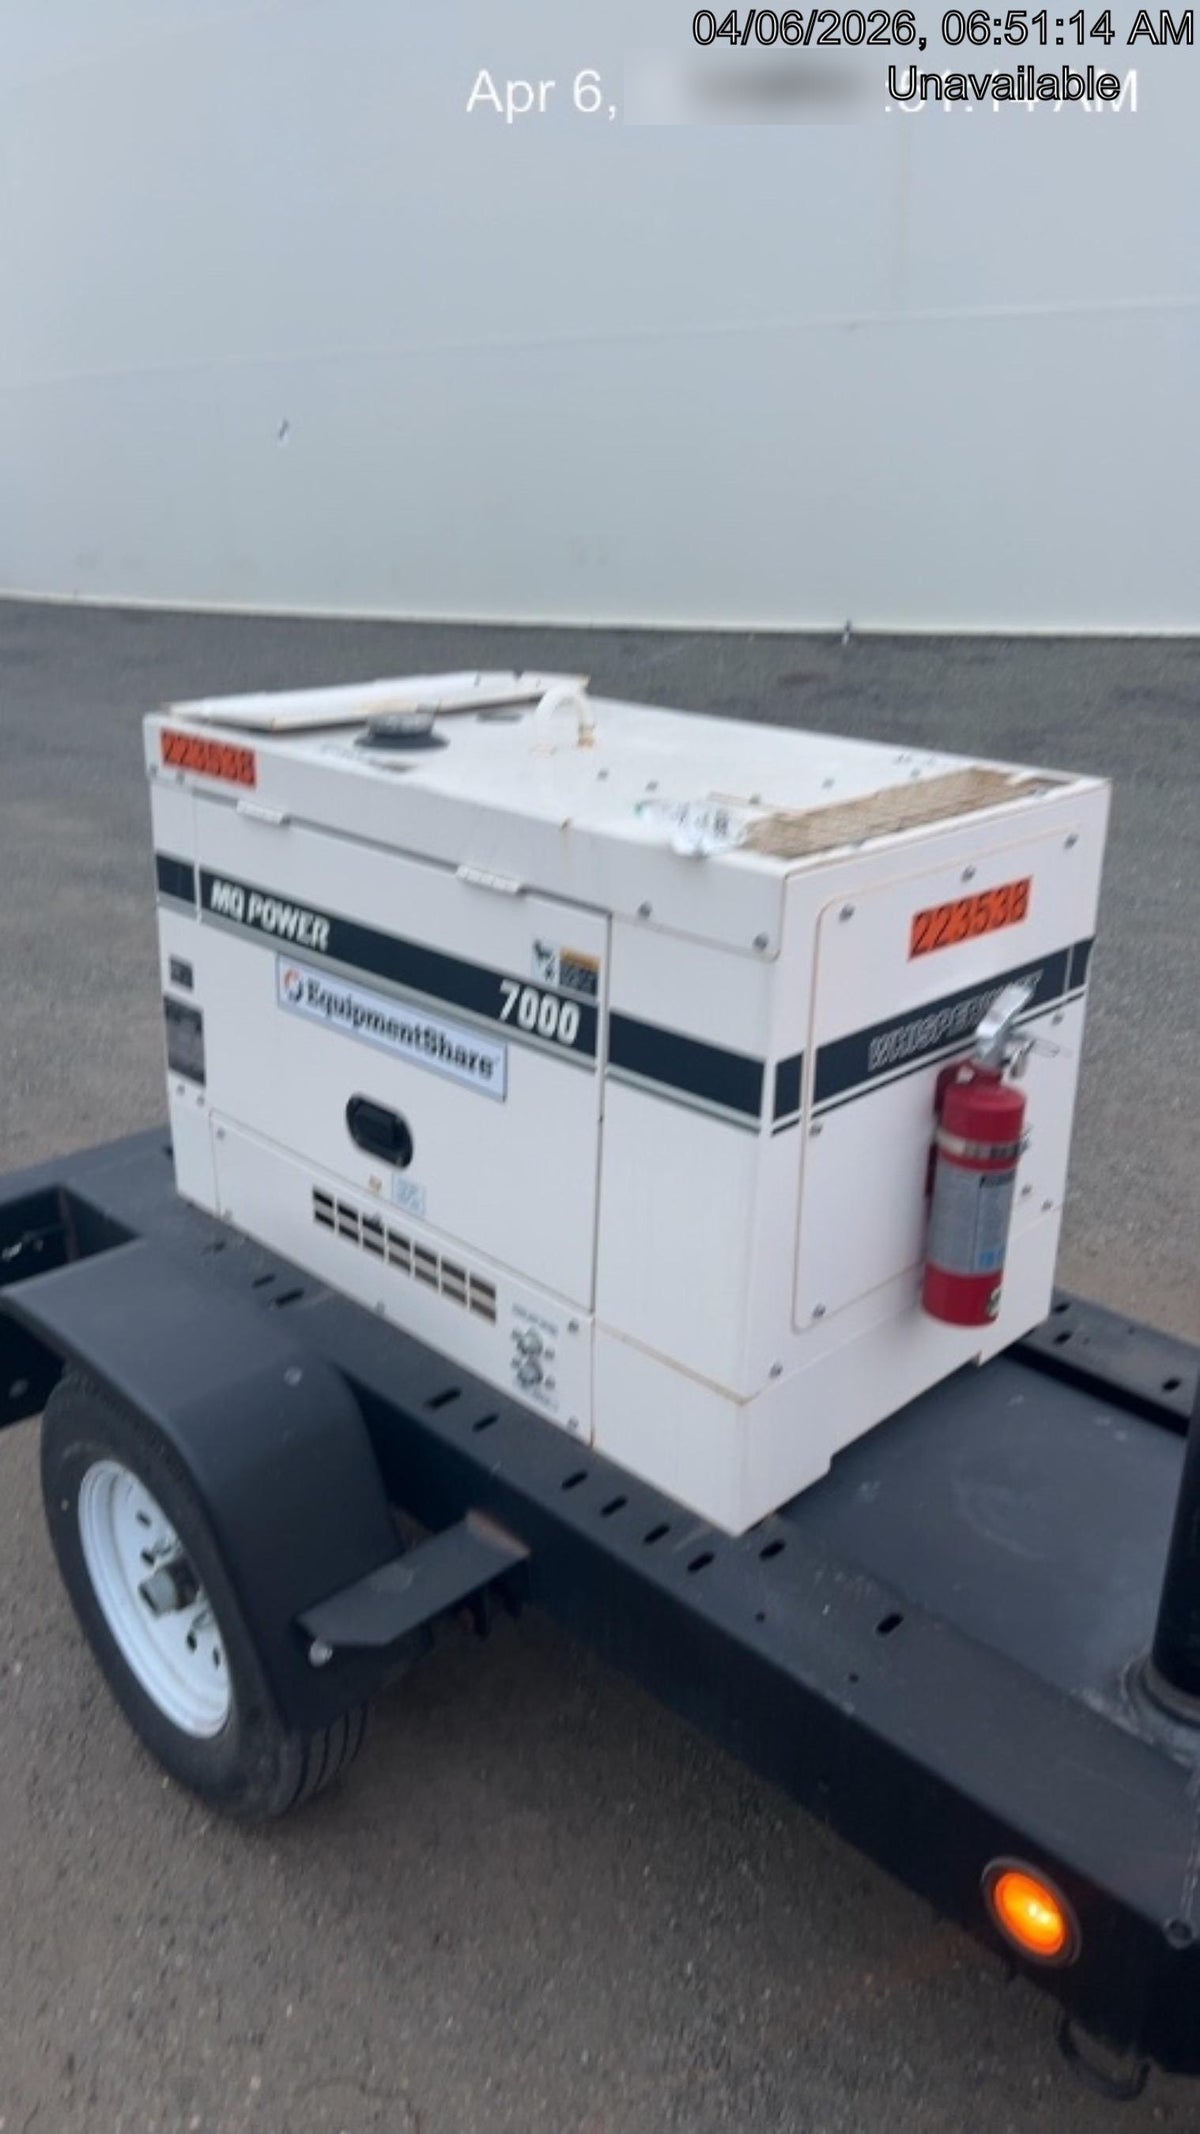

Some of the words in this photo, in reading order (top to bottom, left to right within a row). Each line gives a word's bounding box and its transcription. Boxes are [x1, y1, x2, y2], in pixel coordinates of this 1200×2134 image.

[210, 879, 245, 920] MQ
[246, 890, 330, 951] POWER
[909, 878, 1030, 959] 223538
[304, 974, 494, 1082] EquipmentShare
[500, 978, 580, 1045] 7000
[867, 968, 1044, 1073] WHISPER
